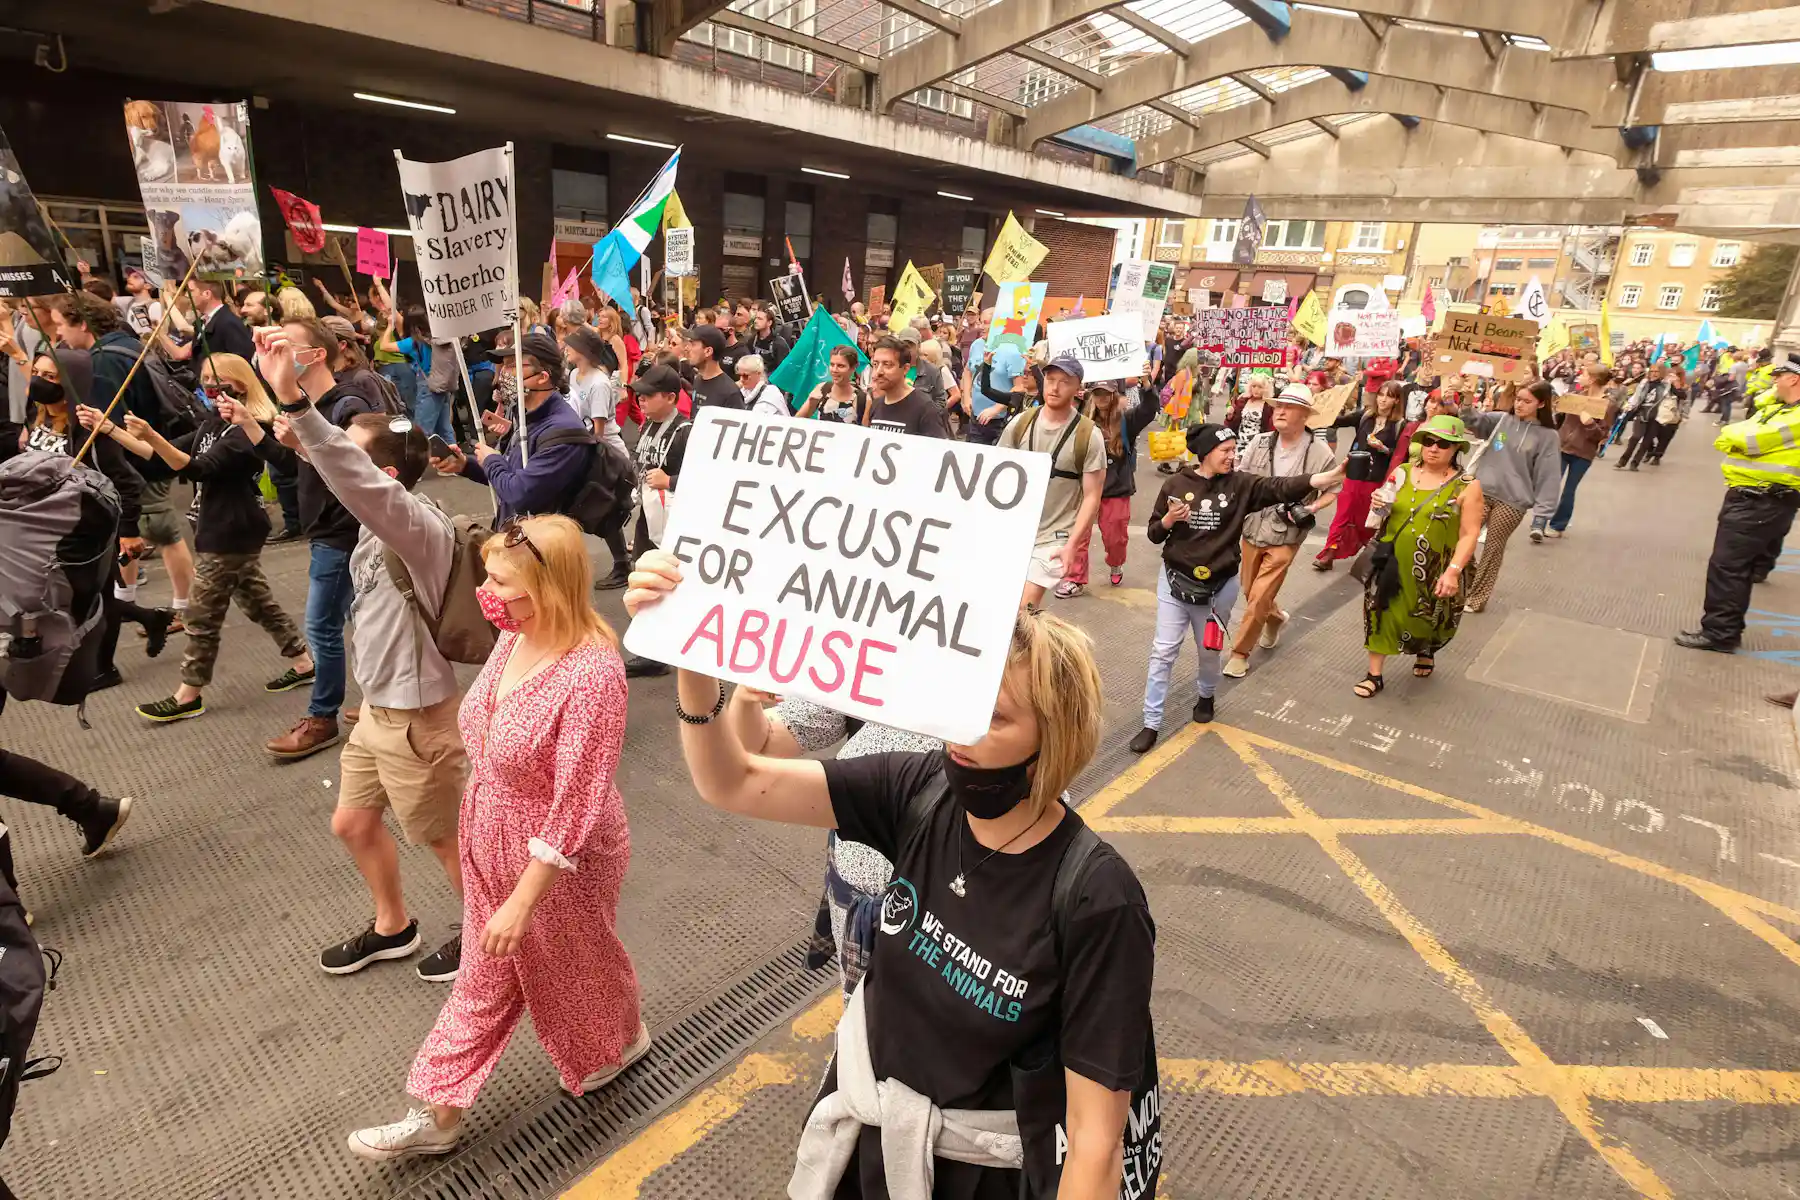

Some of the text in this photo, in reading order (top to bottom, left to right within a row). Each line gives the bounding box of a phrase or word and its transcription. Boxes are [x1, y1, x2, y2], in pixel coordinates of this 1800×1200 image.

[159, 186, 174, 195] why
[437, 175, 509, 233] DAIRY
[427, 227, 507, 260] Slavery
[667, 233, 688, 241] SYSTEM
[947, 274, 971, 283] IF YOU
[950, 284, 965, 292] BUY
[428, 297, 477, 320] MURDER
[481, 292, 494, 310] OF
[791, 294, 803, 303] NOT
[947, 294, 968, 303] THEY
[951, 304, 964, 312] DIE
[1252, 308, 1288, 319] EATING
[1453, 319, 1525, 339] Eat Beans
[1076, 335, 1107, 347] VEGAN
[1447, 335, 1472, 352] Not
[1081, 345, 1101, 360] THE
[1104, 342, 1129, 358] MEAT
[1226, 352, 1281, 365] NOT FOOD
[711, 418, 836, 475] THERE
[854, 436, 903, 487] IS
[934, 449, 1029, 511] NO
[722, 479, 952, 582] EXCUSE
[672, 536, 983, 658] FOR ANIMAL
[680, 603, 898, 708] ABUSE
[921, 910, 1029, 1000] WE STAND FOR
[908, 929, 1023, 1022] THE ANIMALS
